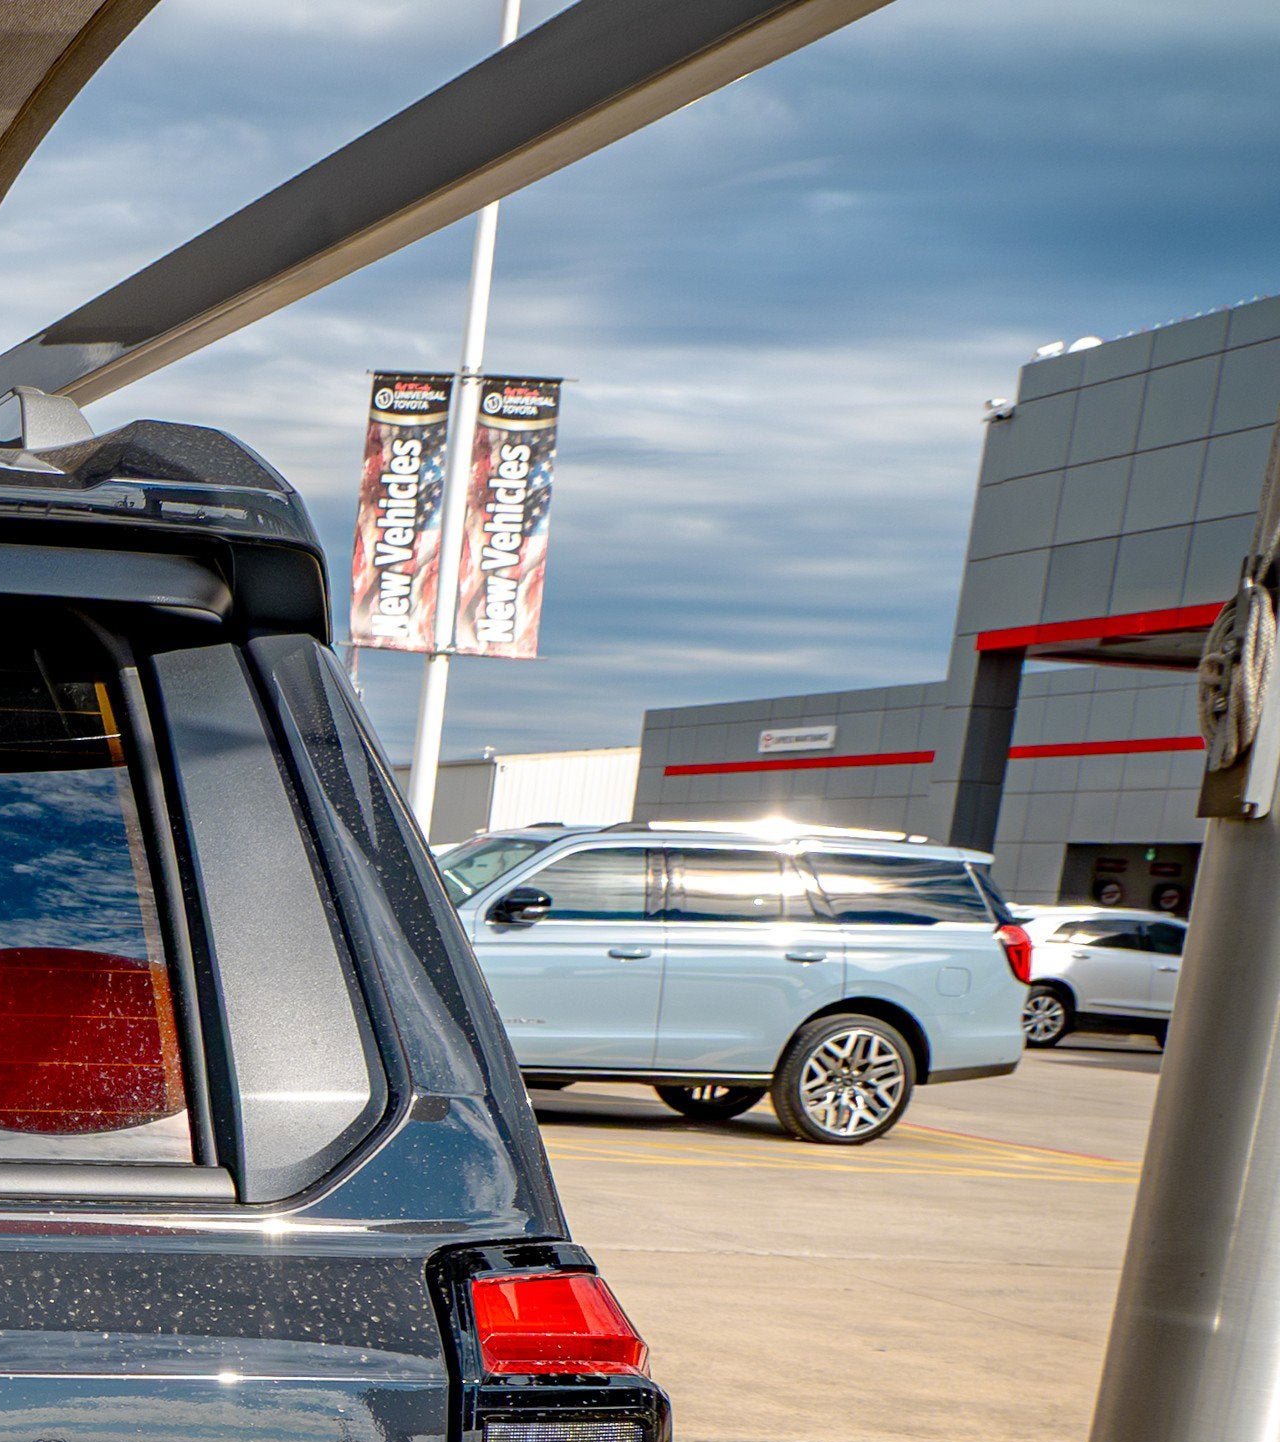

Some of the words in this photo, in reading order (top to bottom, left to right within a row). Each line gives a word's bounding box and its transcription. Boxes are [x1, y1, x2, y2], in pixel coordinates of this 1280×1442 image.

[393, 399, 430, 411] TOYOTA
[394, 390, 447, 402] UNIVERSAL
[502, 405, 538, 416] TOYOTA
[374, 439, 422, 567] Vehicles
[481, 444, 531, 571] Vehicles
[371, 572, 412, 637] New
[477, 576, 518, 642] New
